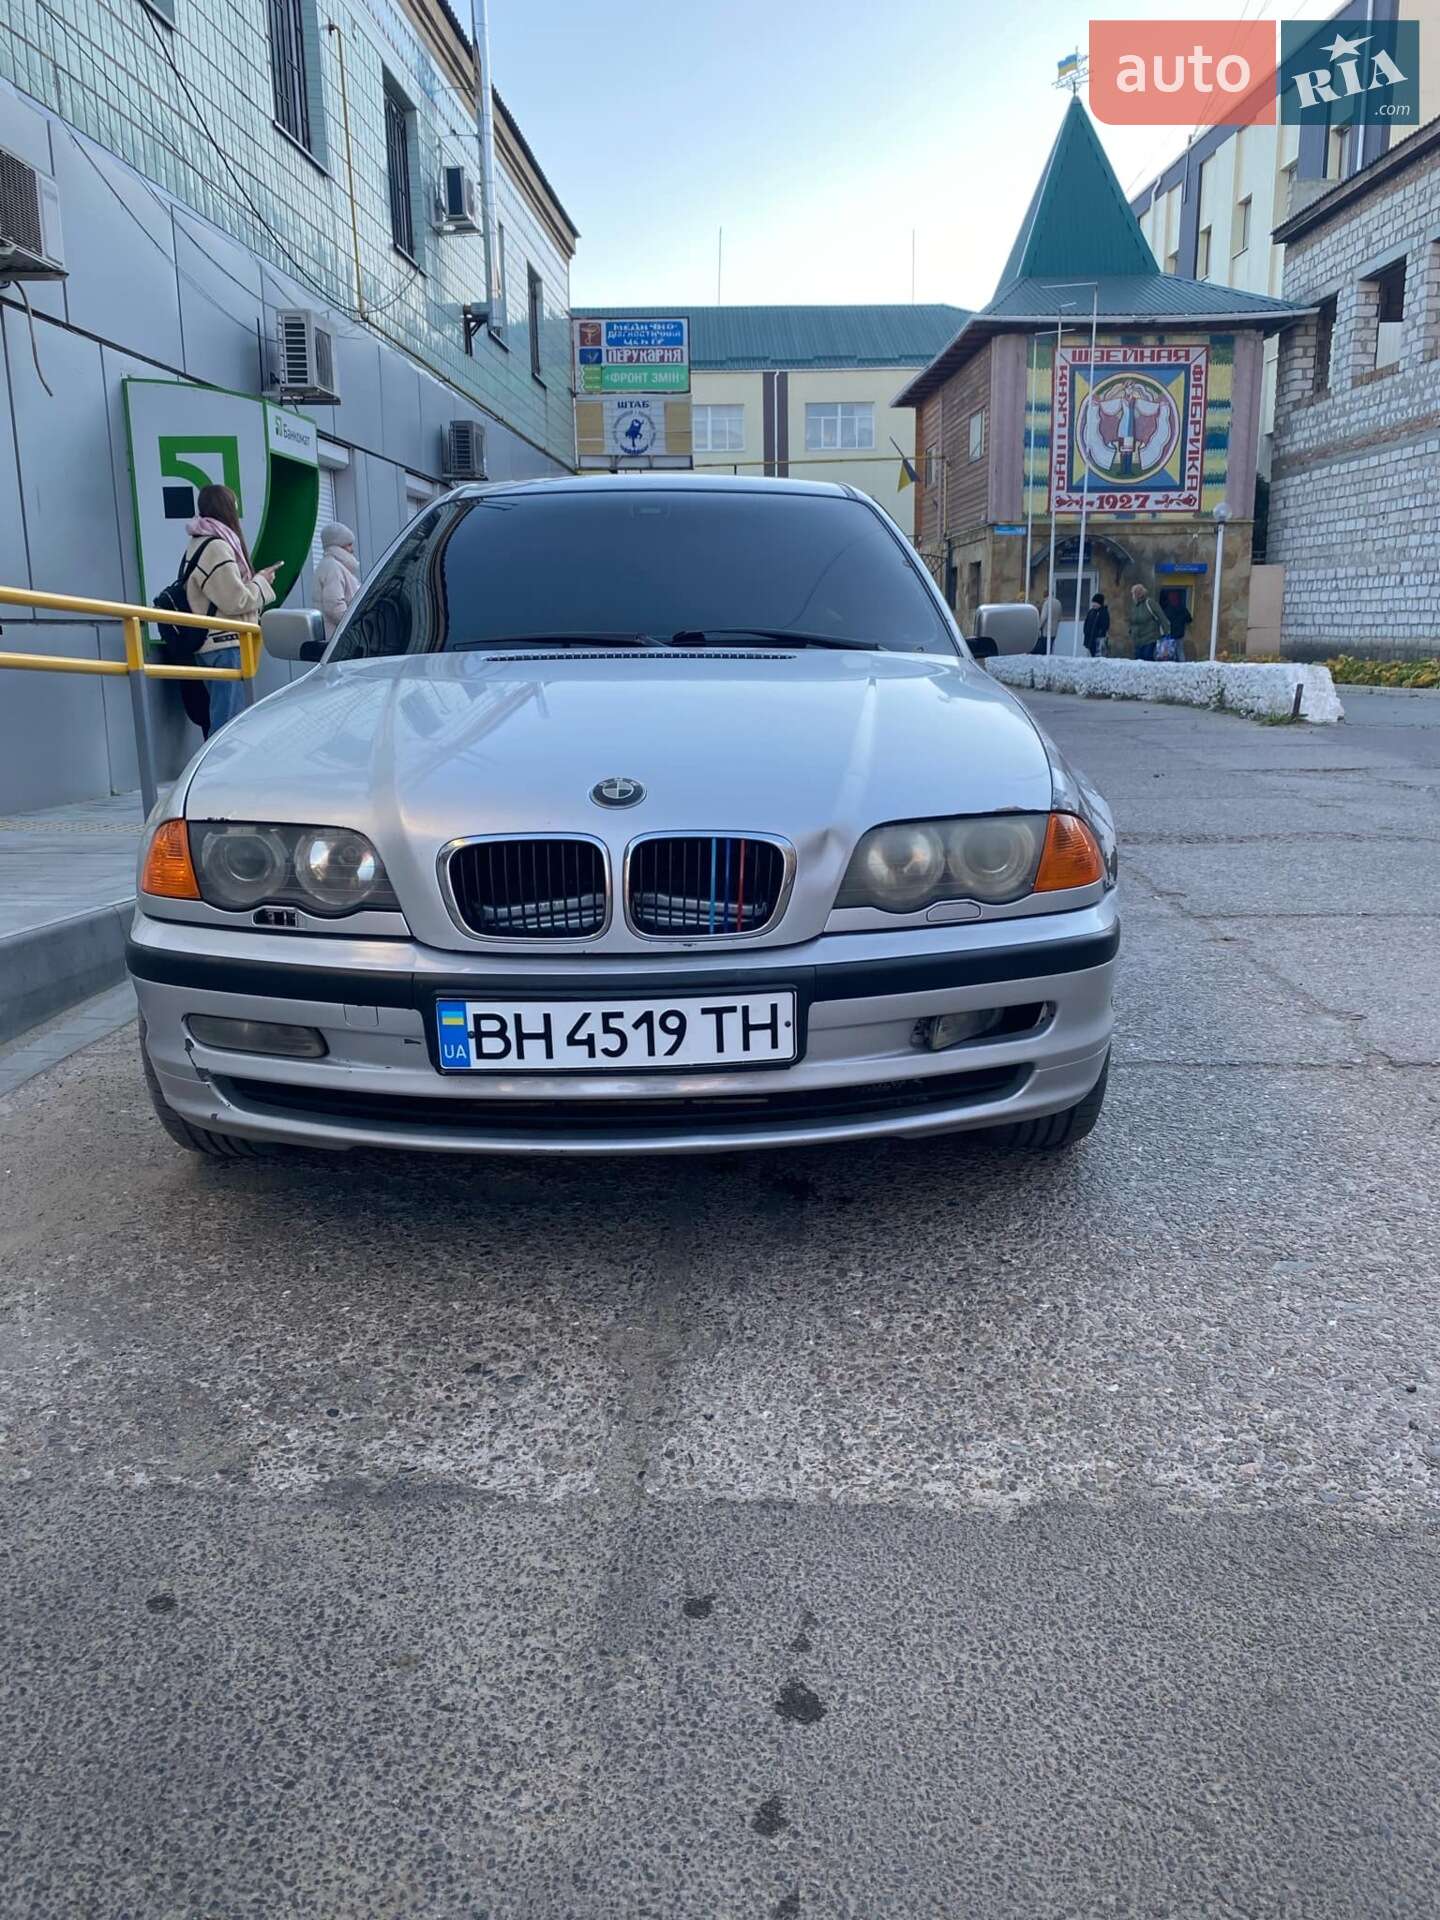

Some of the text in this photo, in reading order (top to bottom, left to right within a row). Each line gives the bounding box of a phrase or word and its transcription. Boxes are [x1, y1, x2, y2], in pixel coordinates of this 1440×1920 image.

[608, 348, 682, 363] ПЕРУКАРНЯ
[1071, 349, 1191, 363] ШВЕЙНАЯ
[617, 400, 650, 408] ШТАБ
[283, 423, 310, 445] Банкомат
[1187, 365, 1204, 491] ФАБРИКА
[1097, 495, 1150, 509] 1927
[566, 1009, 688, 1058] 4519
[444, 1044, 467, 1060] UA
